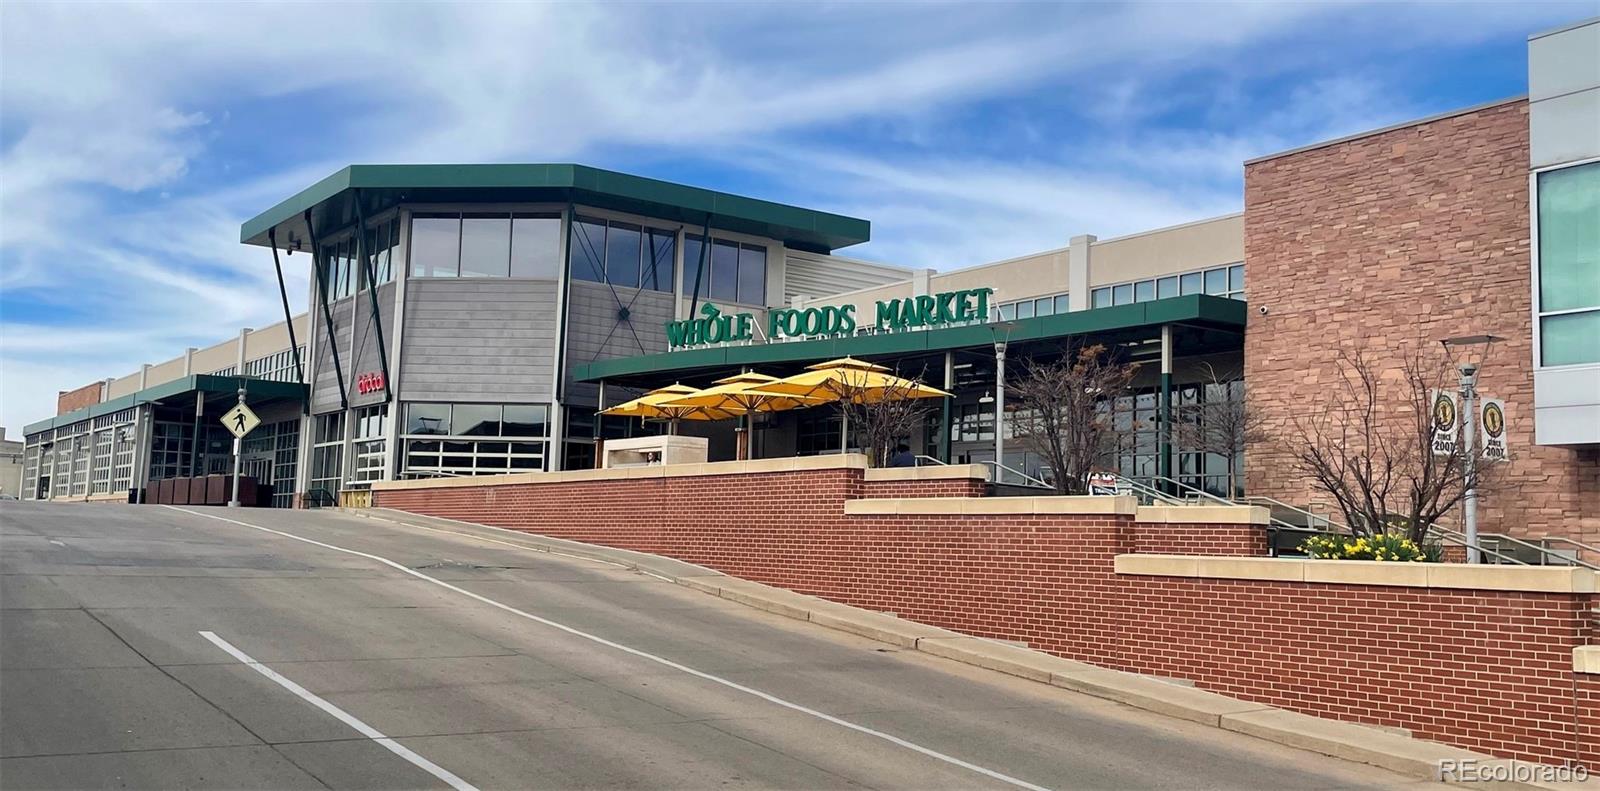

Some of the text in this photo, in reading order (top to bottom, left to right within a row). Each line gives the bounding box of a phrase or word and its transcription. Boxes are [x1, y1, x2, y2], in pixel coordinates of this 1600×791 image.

[665, 287, 994, 348] WHOLE FOODS MARKET
